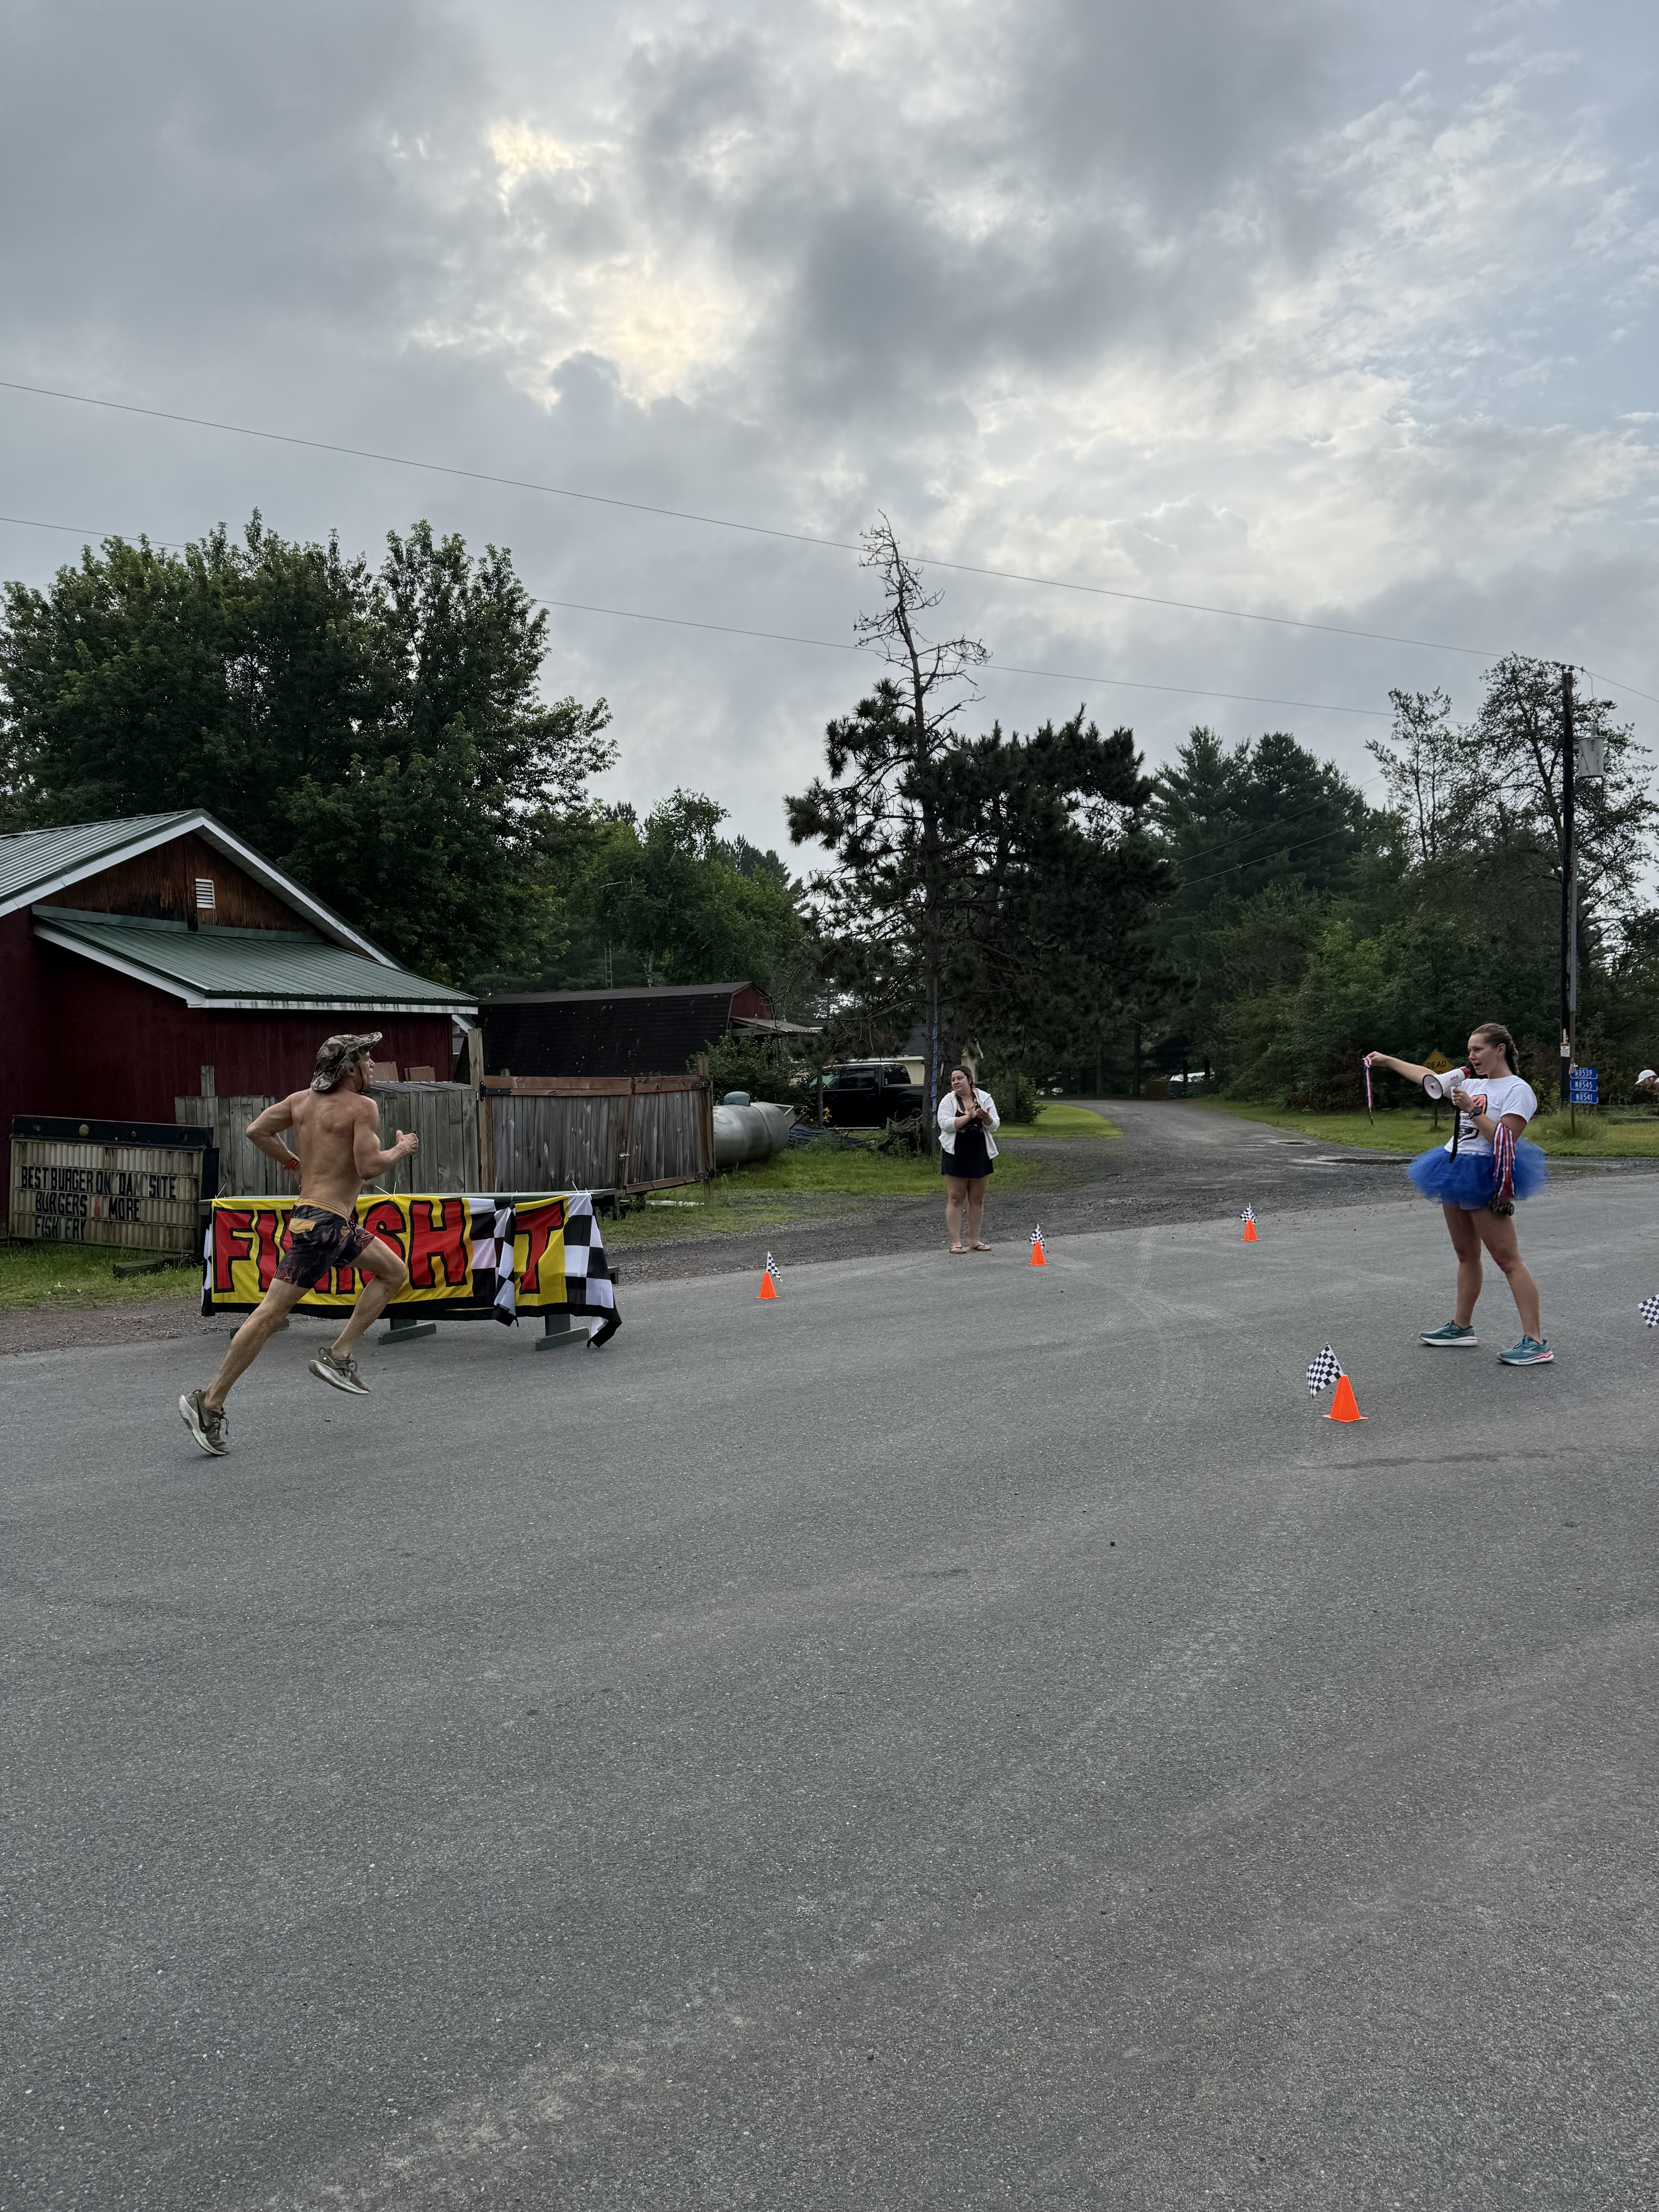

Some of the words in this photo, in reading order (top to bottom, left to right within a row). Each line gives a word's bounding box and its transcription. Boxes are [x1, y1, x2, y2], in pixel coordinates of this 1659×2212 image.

[1427, 1061, 1446, 1069] DEAD
[21, 1166, 48, 1188] BEST
[51, 1168, 93, 1192] BURGER
[96, 1171, 111, 1194] ON
[149, 1175, 176, 1199] SITE
[36, 1190, 88, 1217] BURGERS
[109, 1197, 140, 1221] MORE
[35, 1214, 58, 1238] FISH
[65, 1218, 86, 1240] FRY
[214, 1197, 467, 1295] FISH
